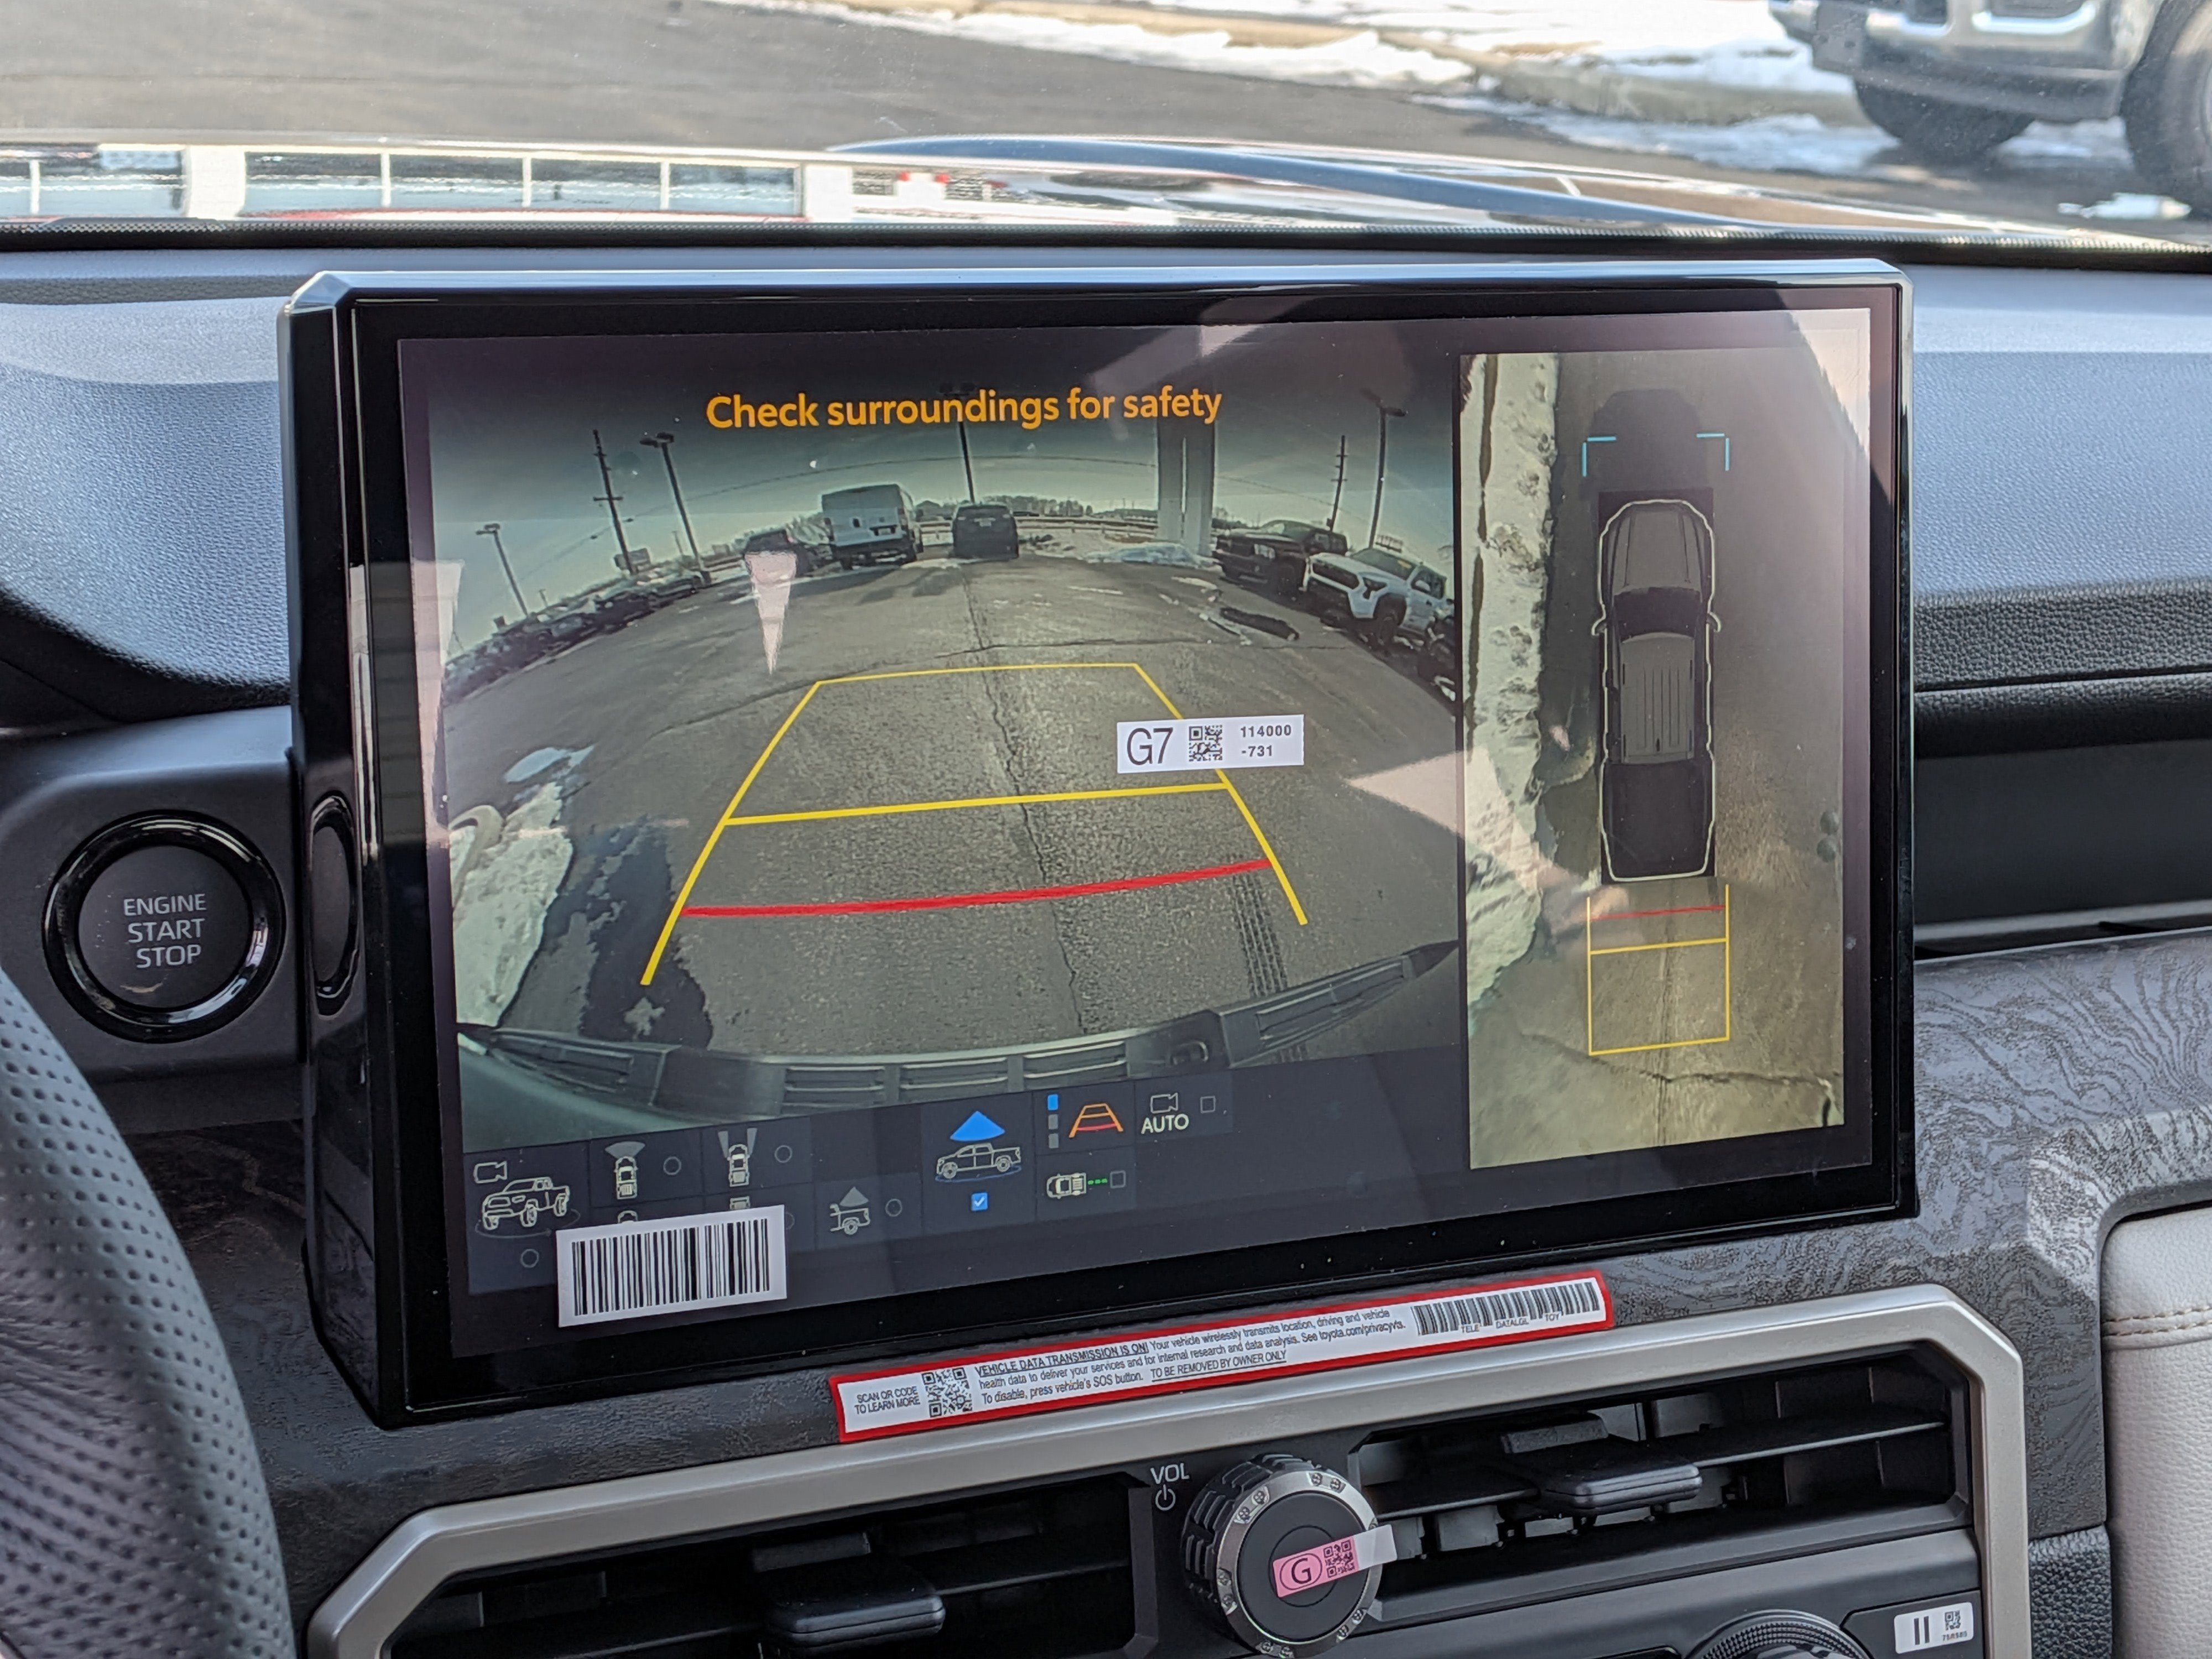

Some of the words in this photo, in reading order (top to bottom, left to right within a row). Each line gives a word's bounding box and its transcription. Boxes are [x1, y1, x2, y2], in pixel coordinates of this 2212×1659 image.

[706, 393, 819, 429] Check
[827, 389, 1060, 430] surroundings
[1067, 387, 1114, 420] for
[1123, 385, 1222, 425] safety
[1240, 724, 1292, 738] 114000
[1126, 727, 1173, 765] G7
[1241, 745, 1272, 757] -731
[124, 894, 207, 916] ENGINE
[128, 919, 205, 943] START
[137, 945, 201, 968] STOP
[1141, 1113, 1190, 1135] AUTO
[974, 1361, 1018, 1376] VEHICLE
[1019, 1358, 1046, 1370] DATA
[1045, 1347, 1119, 1366] TRANSMISSION
[1119, 1345, 1130, 1355] IS
[1149, 1340, 1170, 1350] Your
[1171, 1335, 1201, 1347] vehicle
[1201, 1330, 1241, 1343] wirelessly
[1243, 1324, 1280, 1337] transmits
[1281, 1320, 1316, 1332] location,
[1317, 1316, 1344, 1327] driving
[1345, 1312, 1360, 1323] and
[1362, 1308, 1390, 1321] vehicle
[979, 1376, 1006, 1389] health
[1008, 1374, 1027, 1385] data
[1029, 1373, 1038, 1382] to
[1040, 1368, 1067, 1380] deliver
[1070, 1366, 1088, 1379] your
[1091, 1360, 1125, 1373] services
[1127, 1357, 1143, 1368] and
[1144, 1355, 1156, 1365] for
[1157, 1349, 1188, 1363] internal
[1190, 1344, 1226, 1358] research
[1228, 1342, 1243, 1353] and
[1245, 1340, 1263, 1350] data
[1265, 1334, 1300, 1348] analysis.
[1301, 1333, 1318, 1342] See
[1151, 1367, 1162, 1378] TO
[1164, 1366, 1175, 1376] BE
[1177, 1360, 1219, 1374] REMOVED
[1220, 1358, 1232, 1368] BY
[1233, 1353, 1264, 1366] OWNER
[1265, 1350, 1286, 1361] ONLY
[857, 1392, 879, 1404] SCAN
[894, 1386, 918, 1397] CODE
[982, 1392, 993, 1405] To
[994, 1389, 1027, 1402] disable,
[1030, 1385, 1053, 1399] press
[1055, 1379, 1091, 1393] vehicle's
[1093, 1374, 1113, 1387] SOS
[1114, 1372, 1143, 1384] button.
[854, 1404, 867, 1414] TO
[868, 1400, 895, 1412] LEARN
[896, 1396, 920, 1408] MORE
[1150, 1463, 1190, 1485] VOL
[1291, 1558, 1312, 1584] G
